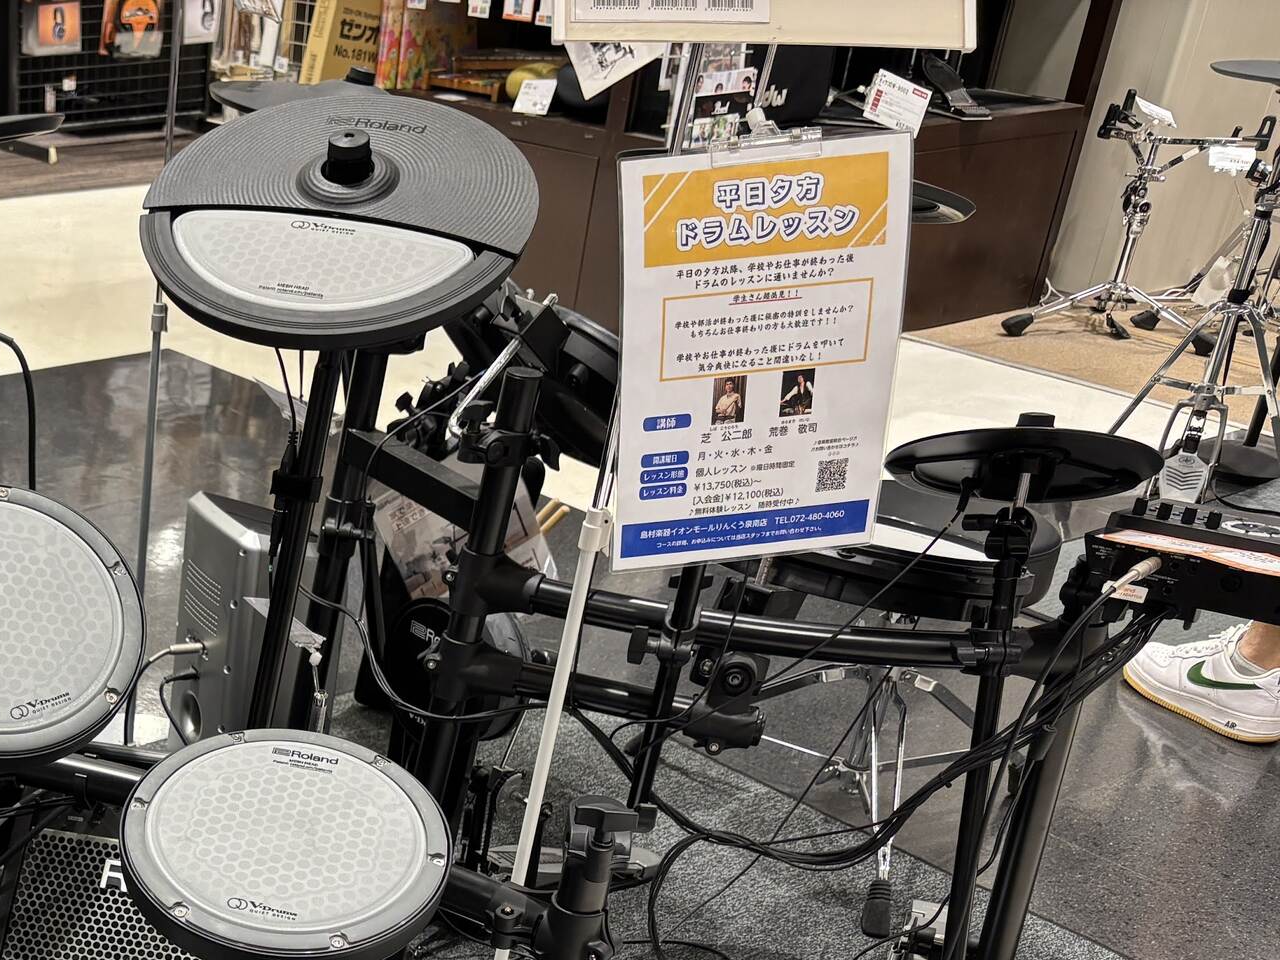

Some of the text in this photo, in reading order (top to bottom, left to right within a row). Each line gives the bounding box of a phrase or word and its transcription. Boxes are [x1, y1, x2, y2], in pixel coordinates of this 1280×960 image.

[354, 117, 427, 134] Roland
[716, 175, 821, 209] 平日夕方
[680, 208, 856, 247] ドラムレッスン
[676, 253, 855, 279] 平日の夕方以降、学校やお仕事が終わった後
[695, 268, 835, 290] ドラムのレッスンに通いませんか？
[656, 416, 676, 430] 講師
[701, 433, 712, 444] 芝
[721, 428, 753, 441] 公二郎
[768, 425, 788, 438] 荒巻
[697, 444, 774, 461] 月・火・水・木・金
[644, 469, 685, 482] レッスン形態
[695, 463, 746, 478] 個人レッスン
[642, 485, 684, 497] レッスン料金
[774, 509, 845, 525] TEL.072-480-4060
[26, 692, 70, 708] V-Drums
[32, 705, 49, 714] QUIET
[1224, 720, 1238, 730] AIR
[291, 750, 339, 765] Roland
[250, 900, 298, 917] V-Drums
